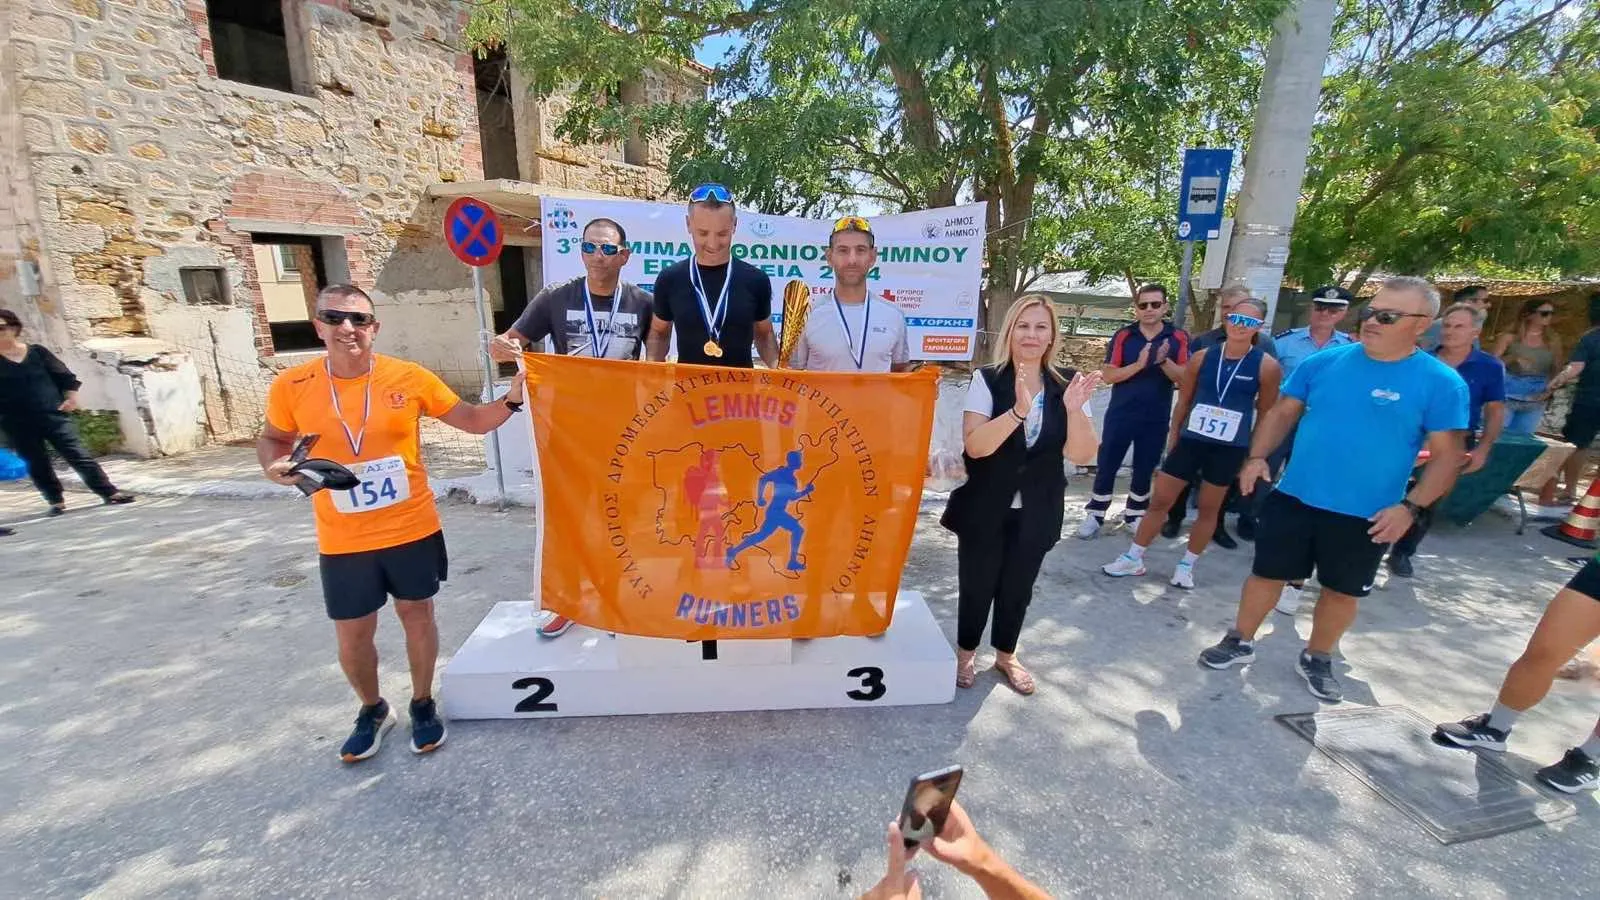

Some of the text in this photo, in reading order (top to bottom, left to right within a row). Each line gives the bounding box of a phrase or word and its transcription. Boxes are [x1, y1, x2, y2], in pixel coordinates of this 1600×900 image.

[945, 216, 974, 227] ΔΗΜΟΣ
[945, 228, 979, 238] ΛΗΜΝΟΥ
[876, 246, 968, 262] ΗΜΝΟΥ
[819, 265, 881, 281] 24
[686, 392, 797, 428] LEMNOS
[607, 390, 671, 485] ΔΡΟΜΕΩΝ
[674, 370, 751, 396] ΥΓΕΙΑΣ
[759, 373, 772, 385] &
[782, 376, 879, 497] ΠΕΡΙΠΑΤΗΤΩΝ
[675, 591, 800, 627] RUNNERS
[511, 677, 558, 713] 2
[846, 666, 887, 701] 3
